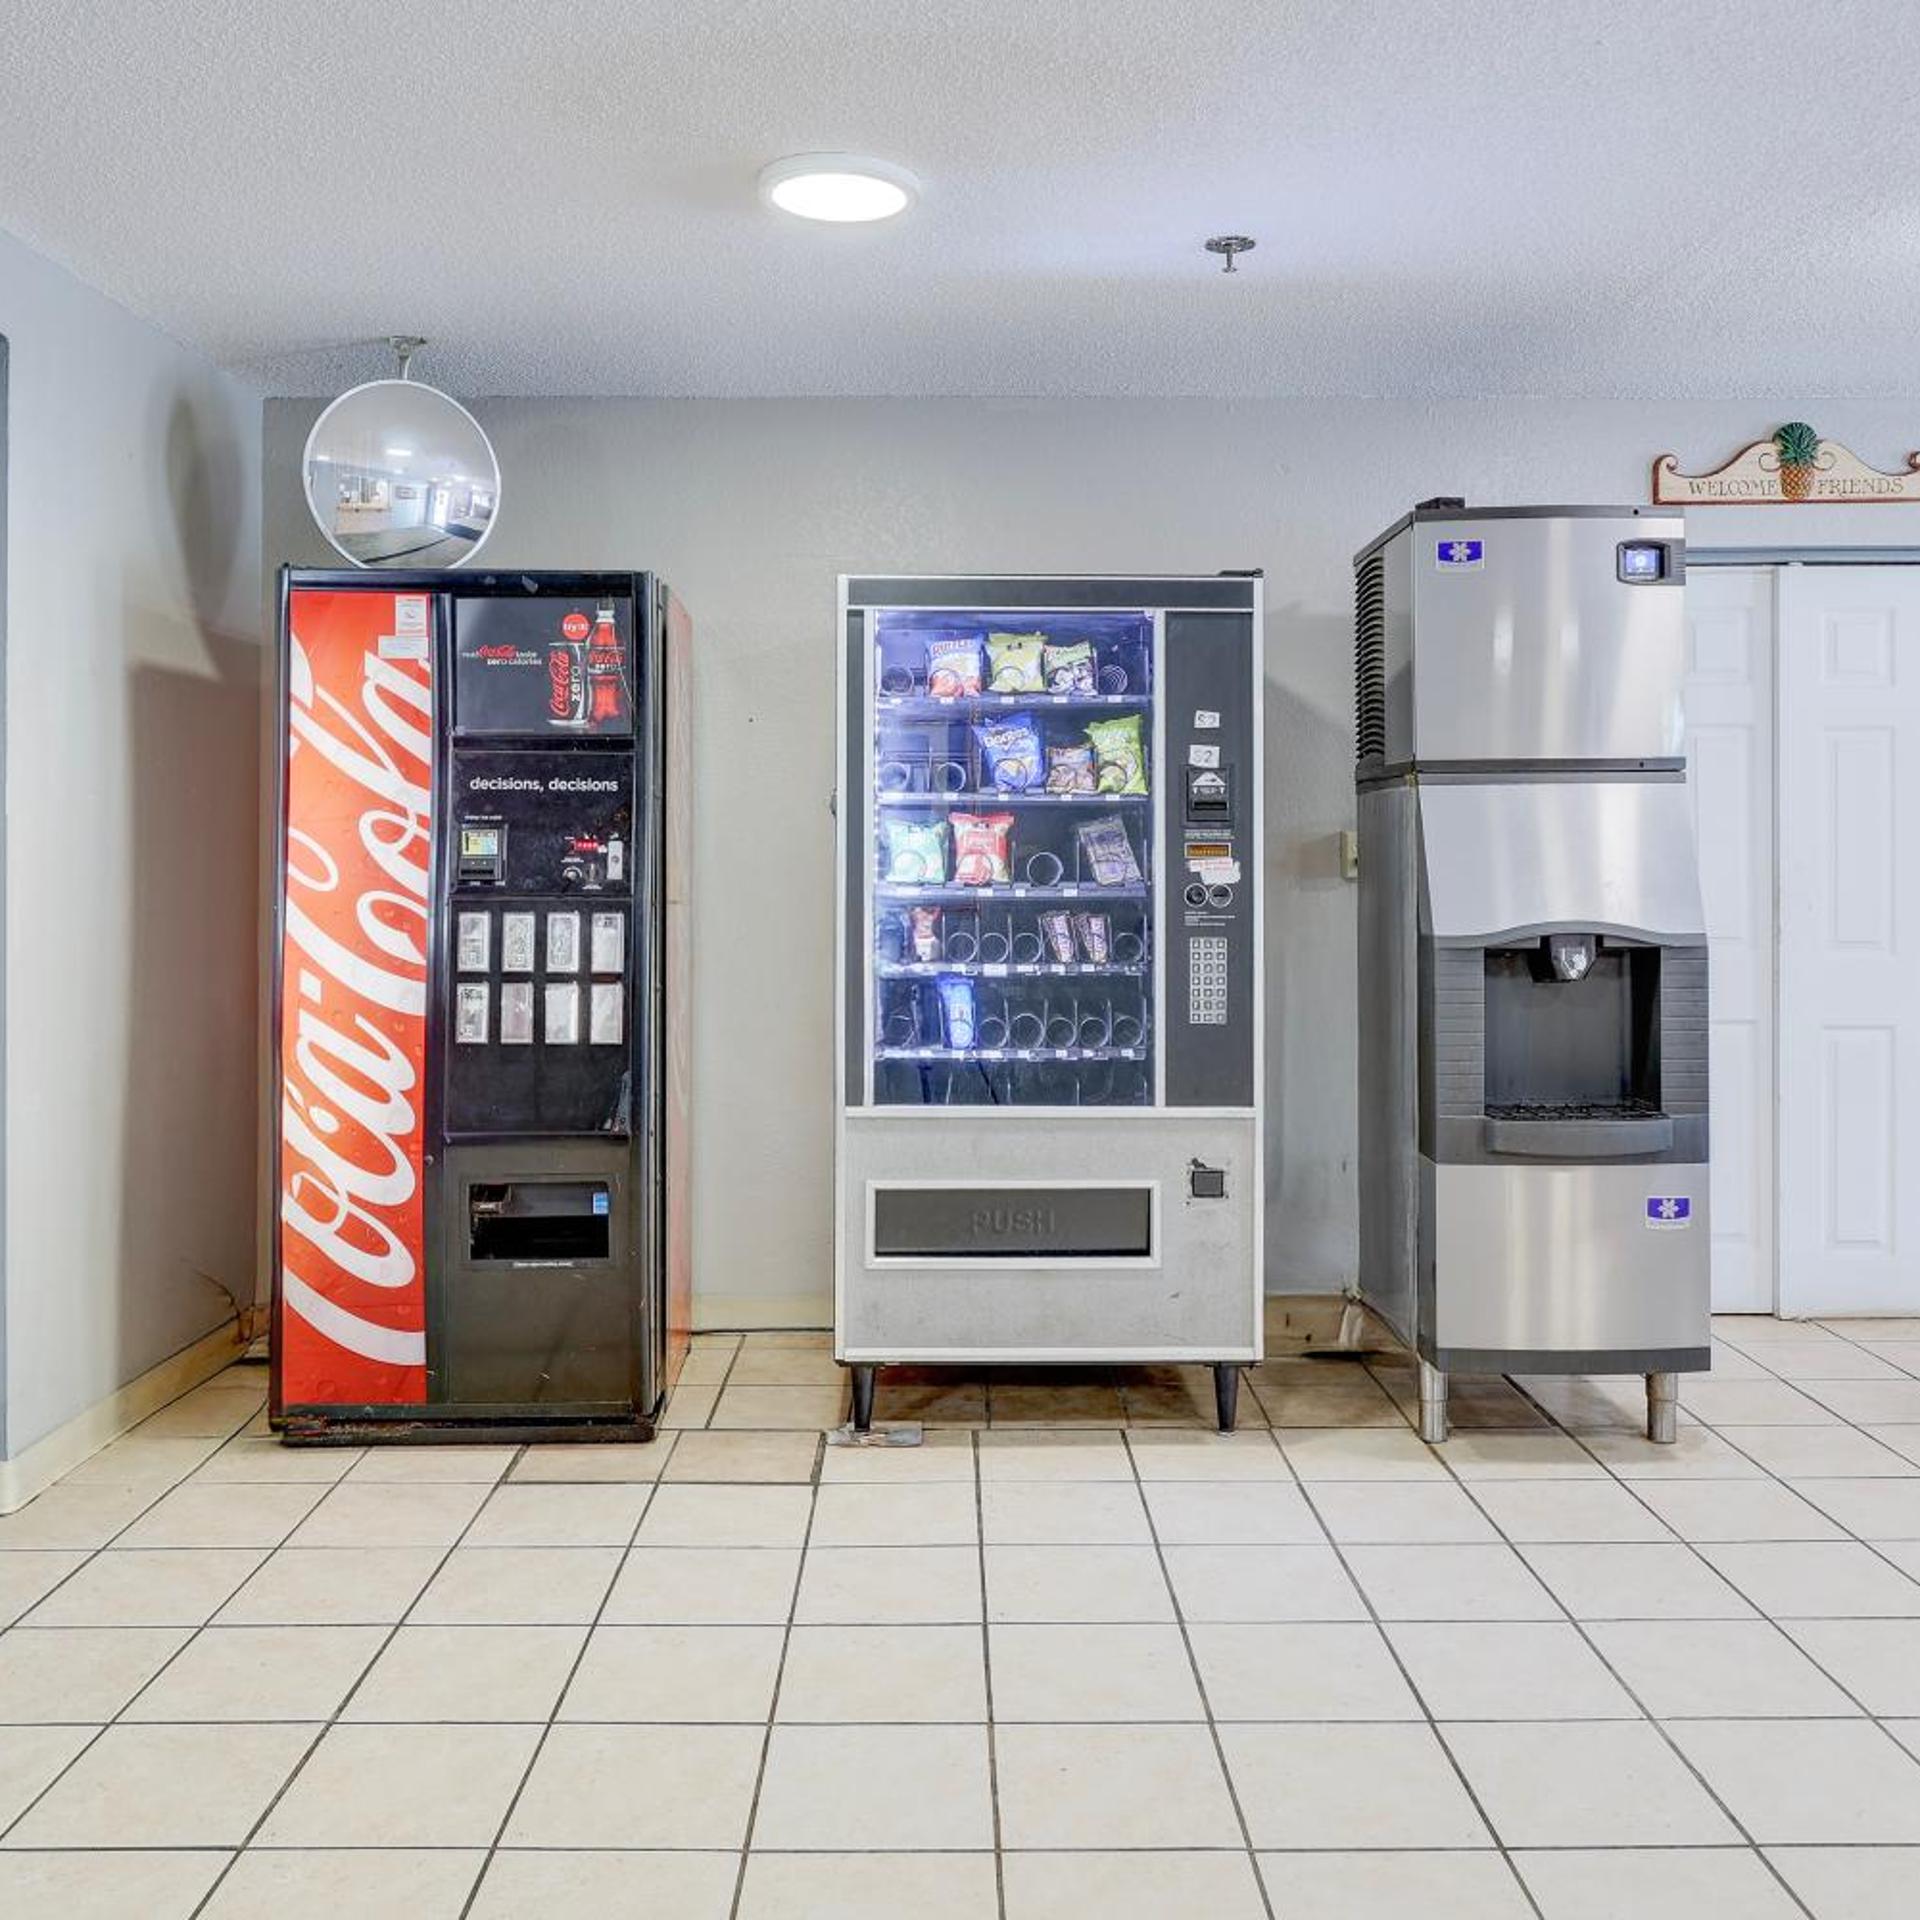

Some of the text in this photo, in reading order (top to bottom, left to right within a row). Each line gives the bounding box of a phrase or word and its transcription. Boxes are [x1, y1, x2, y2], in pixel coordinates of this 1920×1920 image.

[1688, 477, 1905, 497] WELCOME FRIENDS
[571, 666, 582, 702] zero
[469, 776, 619, 792] decisions, decisions
[972, 1208, 1056, 1235] PUSH
